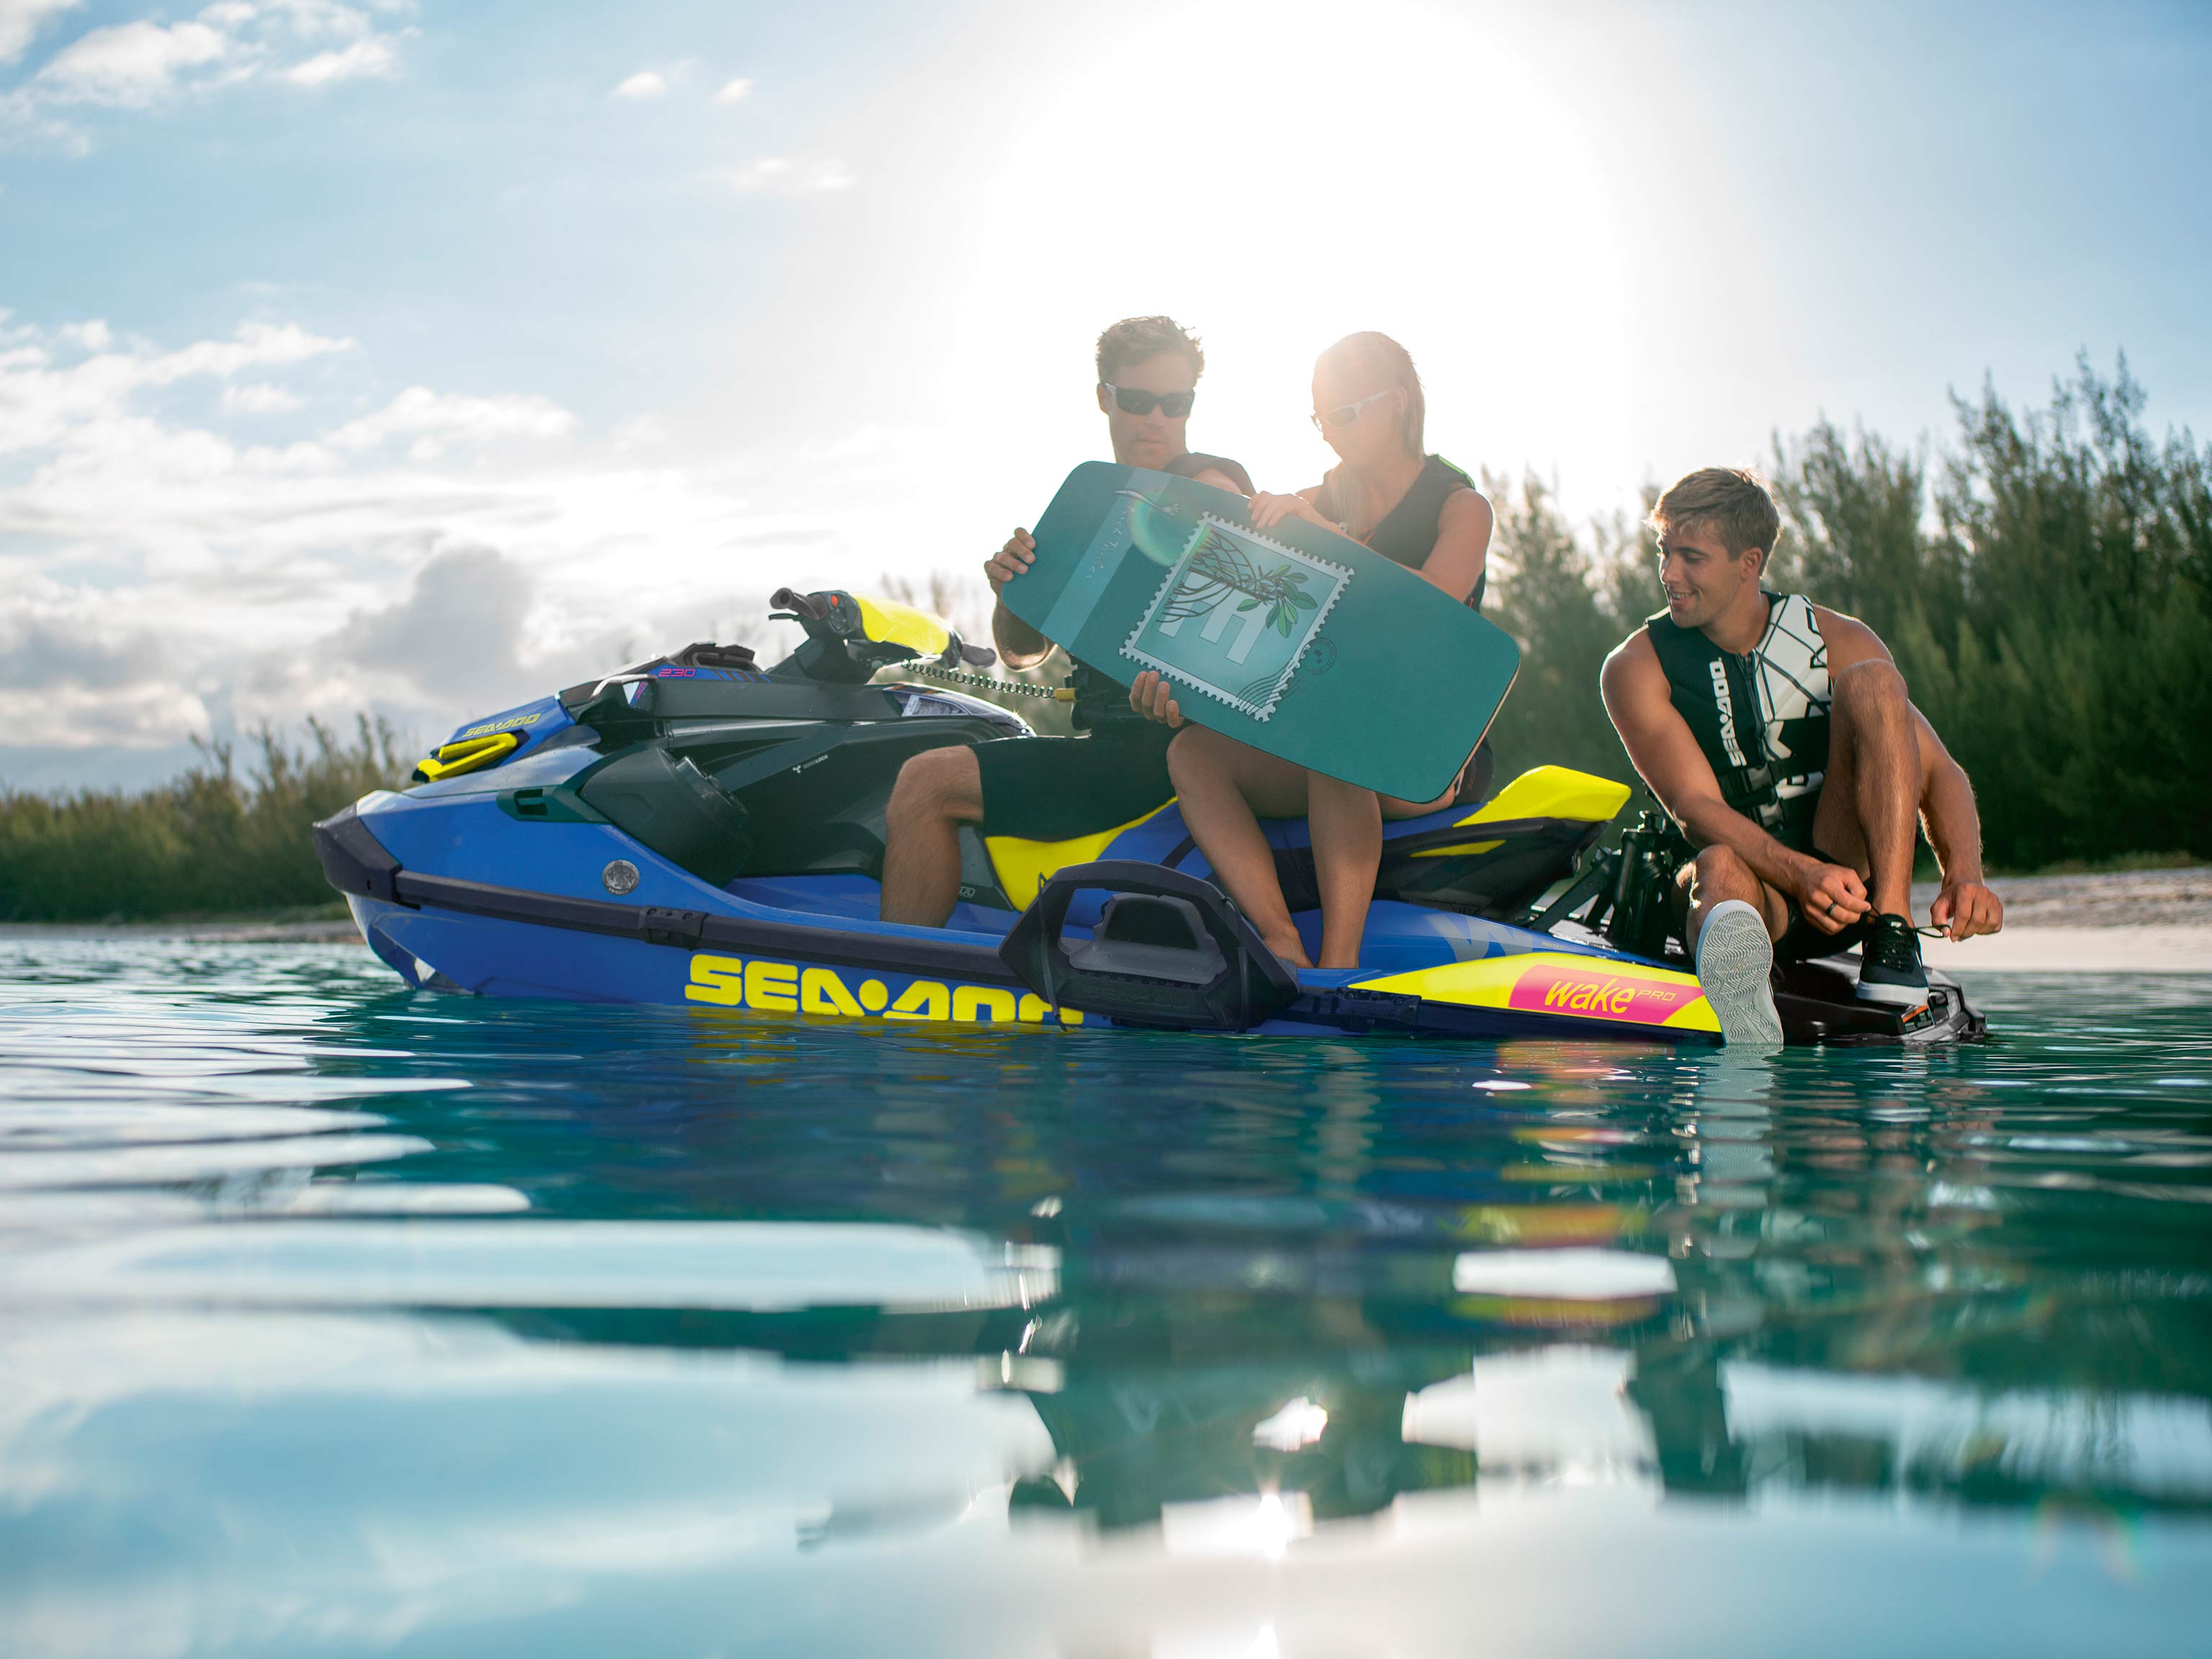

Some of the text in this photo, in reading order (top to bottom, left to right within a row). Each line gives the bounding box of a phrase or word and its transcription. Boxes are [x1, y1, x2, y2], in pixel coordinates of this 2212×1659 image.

[658, 668, 696, 678] 230
[1545, 978, 1676, 1014] wake PRO
